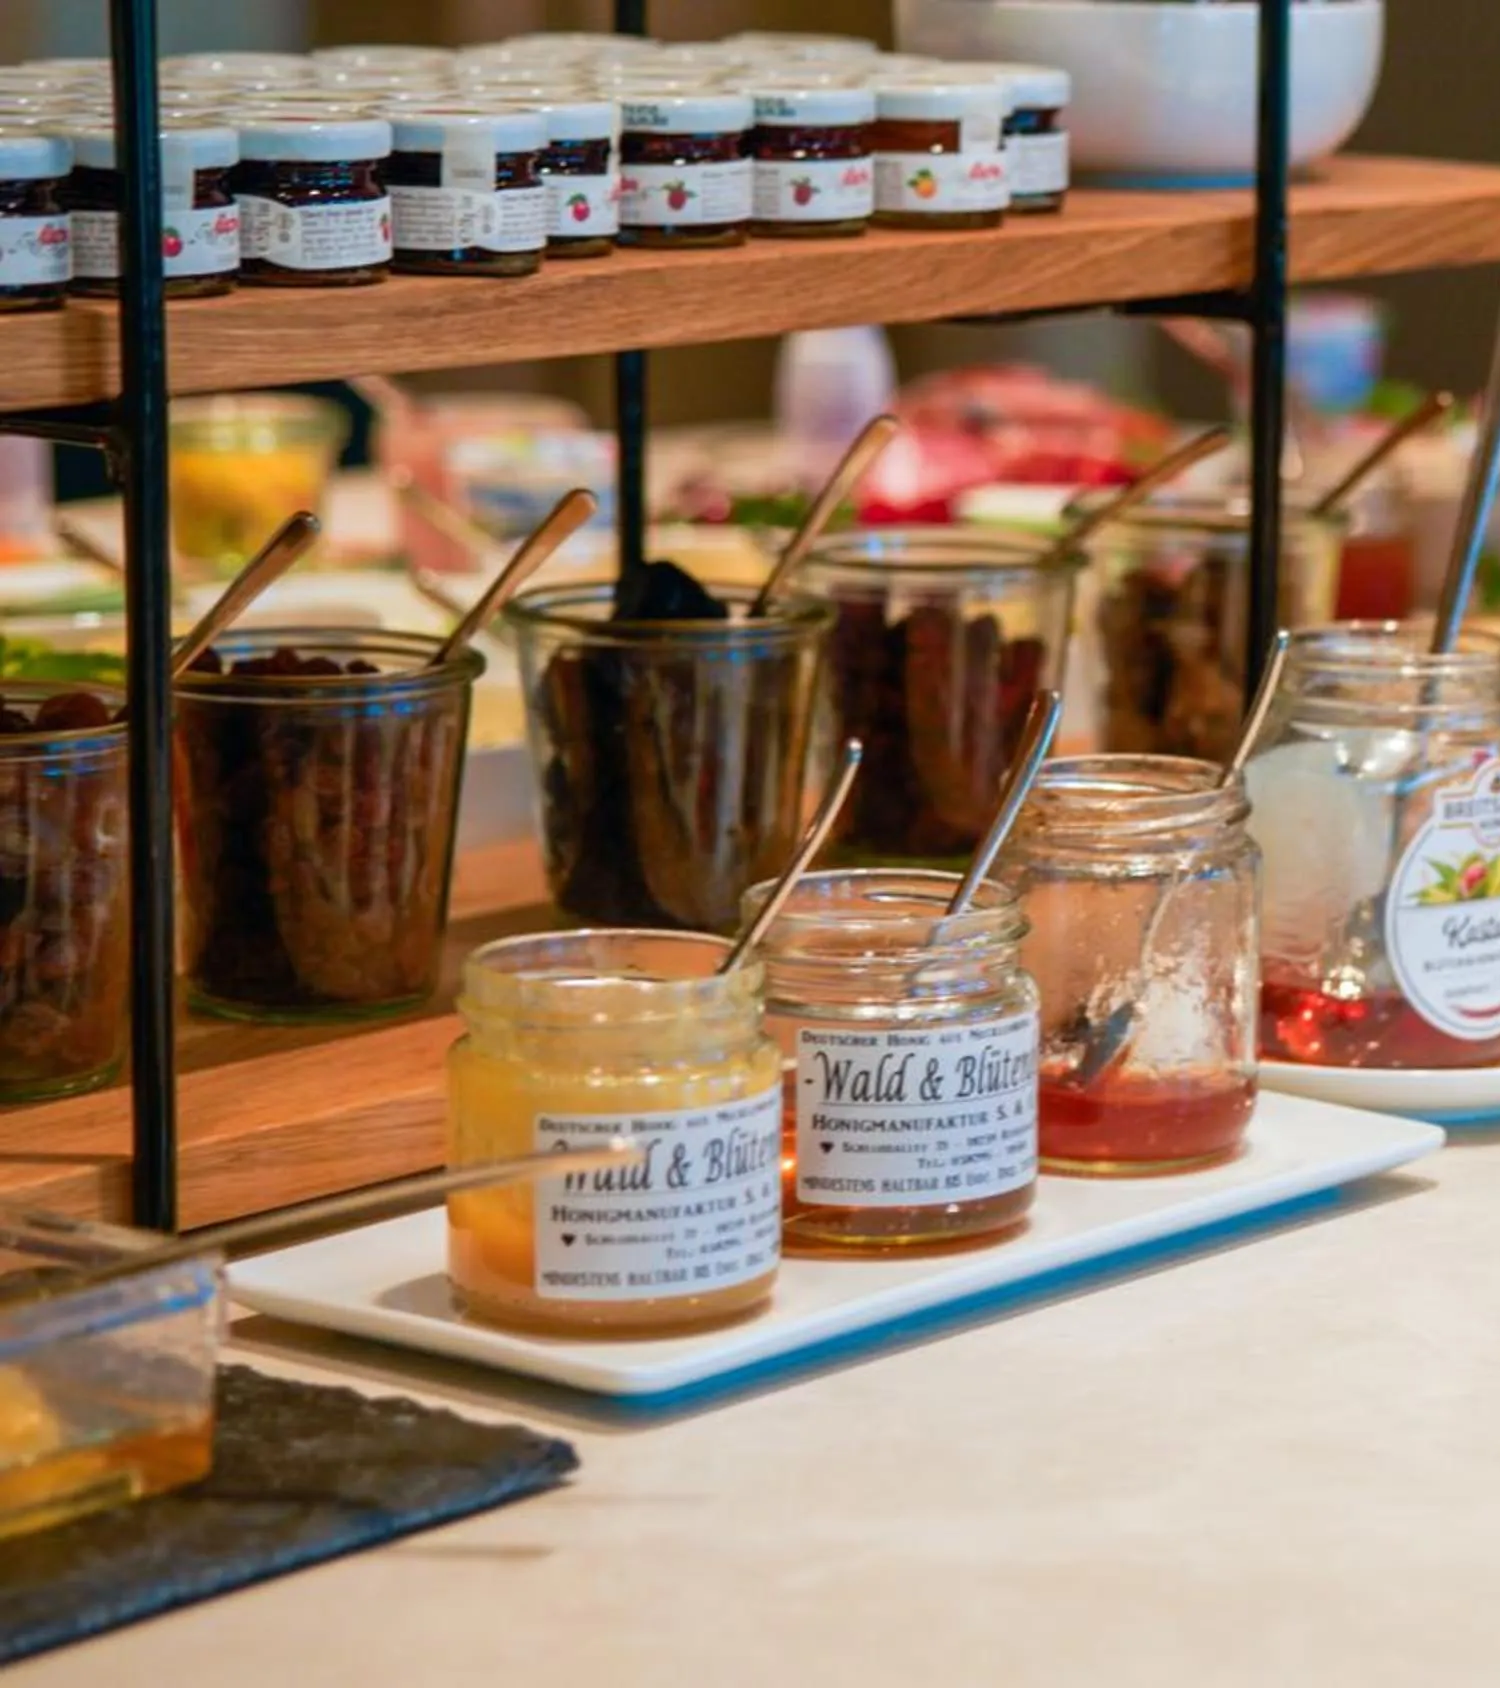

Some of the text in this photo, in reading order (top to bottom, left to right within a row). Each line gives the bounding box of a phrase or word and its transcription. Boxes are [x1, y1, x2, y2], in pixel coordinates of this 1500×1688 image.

[919, 1057, 944, 1101] &
[811, 1111, 988, 1133] HONIGMANUFAKTUR
[666, 1143, 693, 1190] &
[551, 1197, 737, 1222] HONIGMANUFAKTUR
